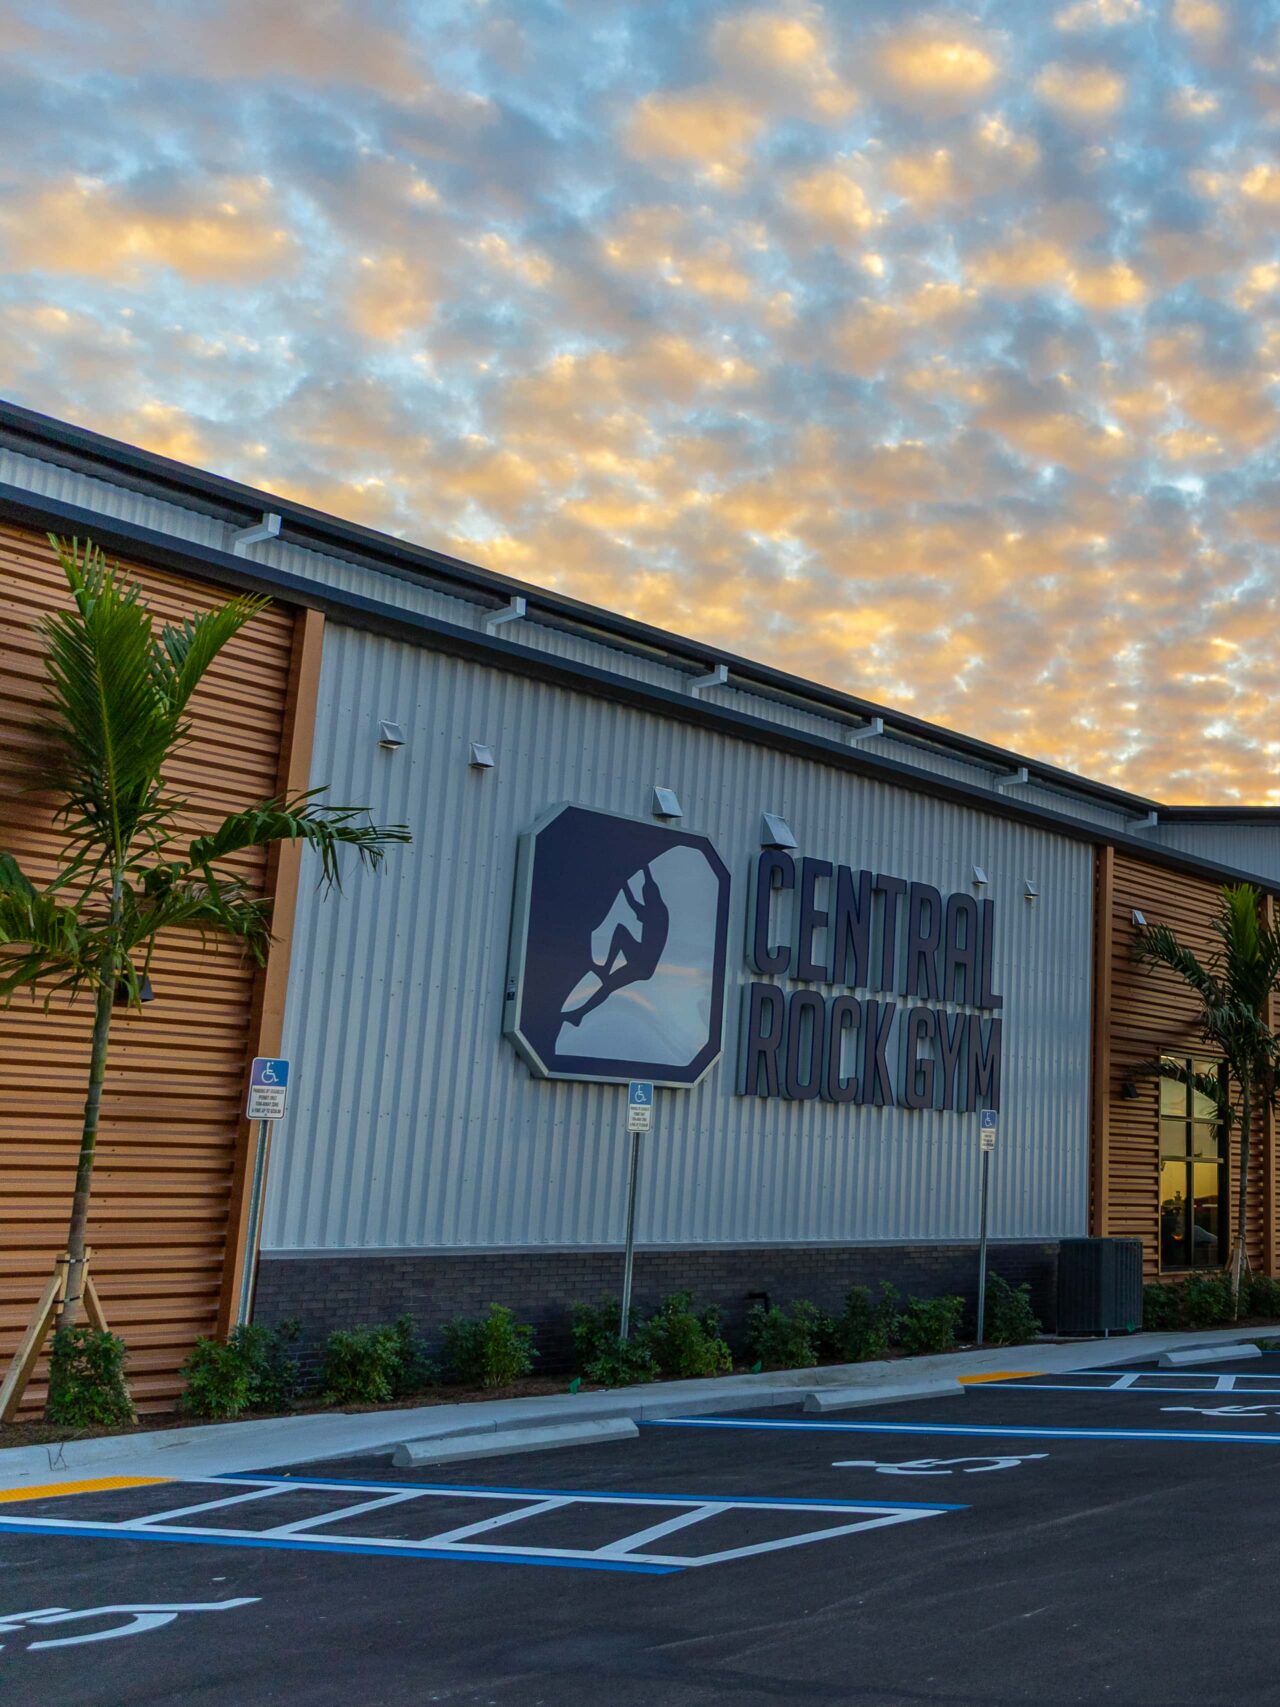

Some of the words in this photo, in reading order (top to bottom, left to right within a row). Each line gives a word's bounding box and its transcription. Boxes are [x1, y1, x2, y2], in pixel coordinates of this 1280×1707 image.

[750, 849, 1003, 1009] CENTRAL
[741, 981, 896, 1106] ROCK
[902, 1006, 1002, 1113] GYM
